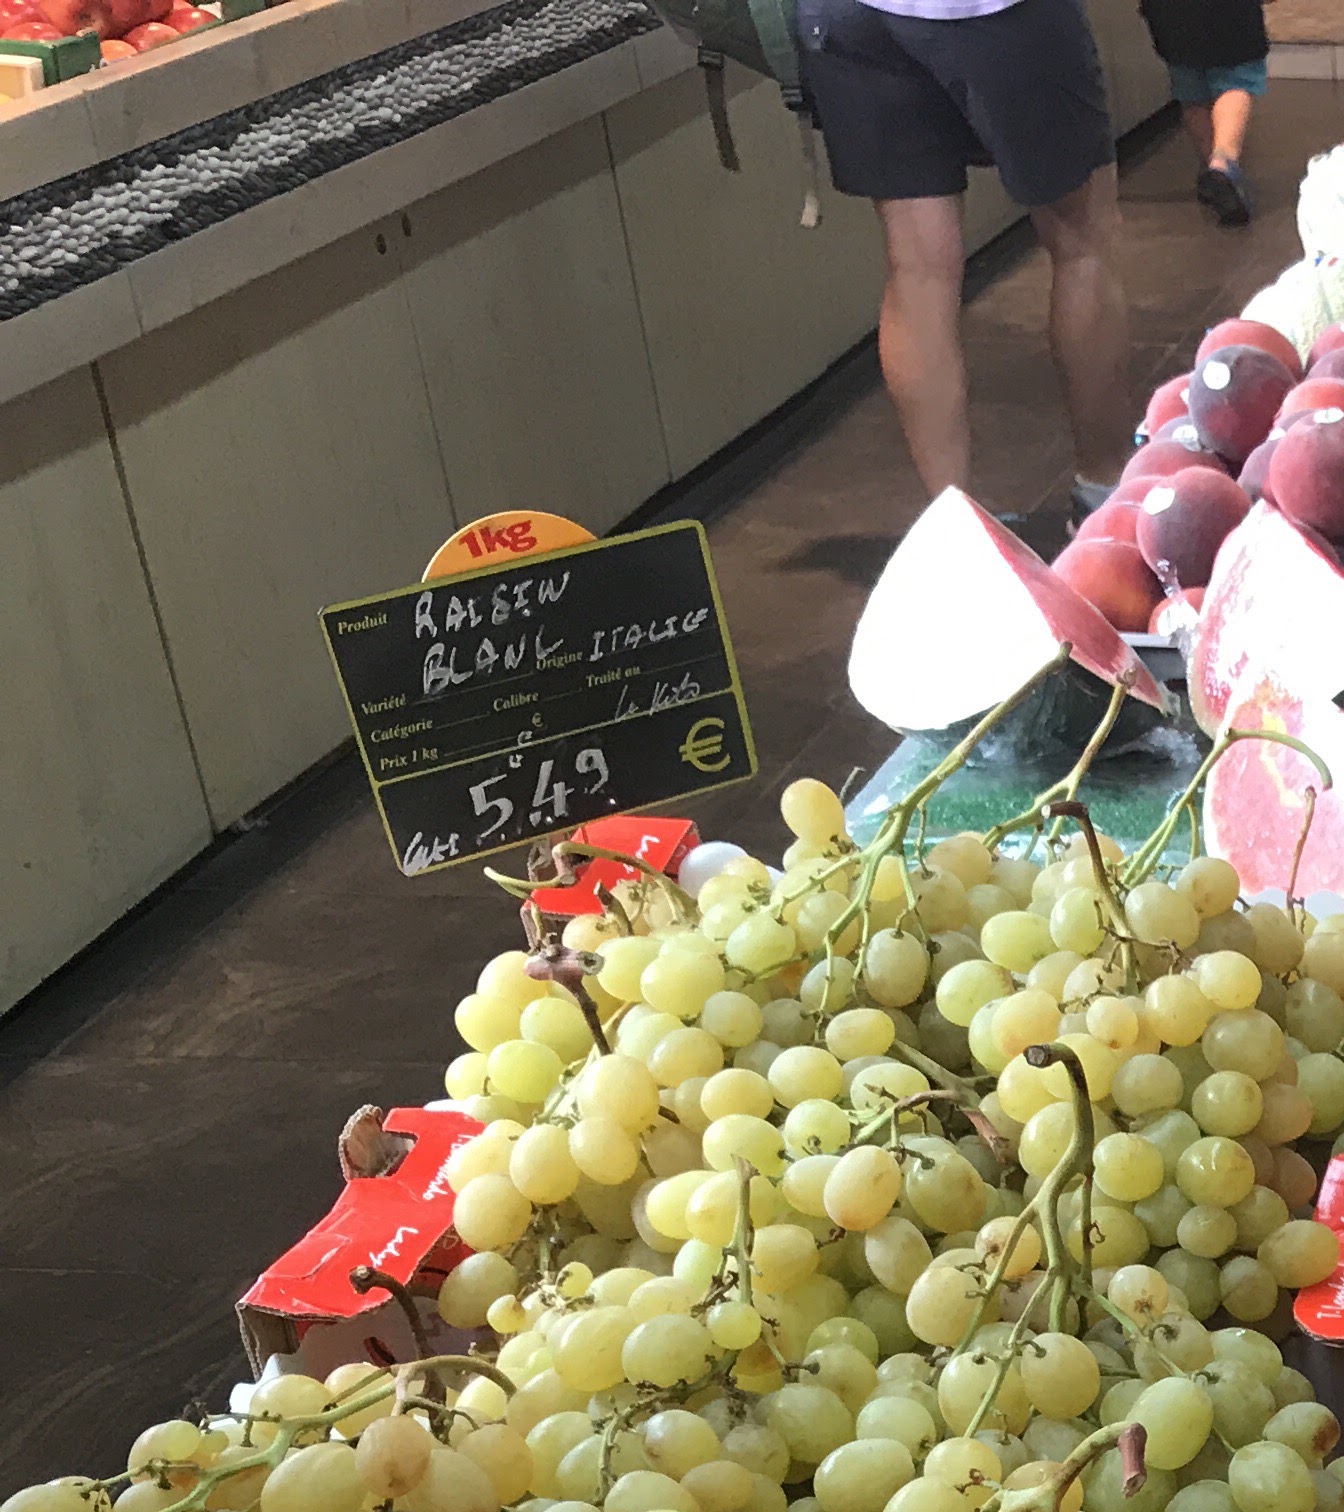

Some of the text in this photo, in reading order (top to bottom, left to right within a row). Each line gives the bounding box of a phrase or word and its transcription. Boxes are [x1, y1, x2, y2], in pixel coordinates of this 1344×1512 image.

[459, 519, 538, 559] 1kg
[338, 612, 388, 635] Produit
[371, 718, 434, 744] Catégorie
[493, 692, 540, 712] Calibre
[380, 752, 408, 771] Prix
